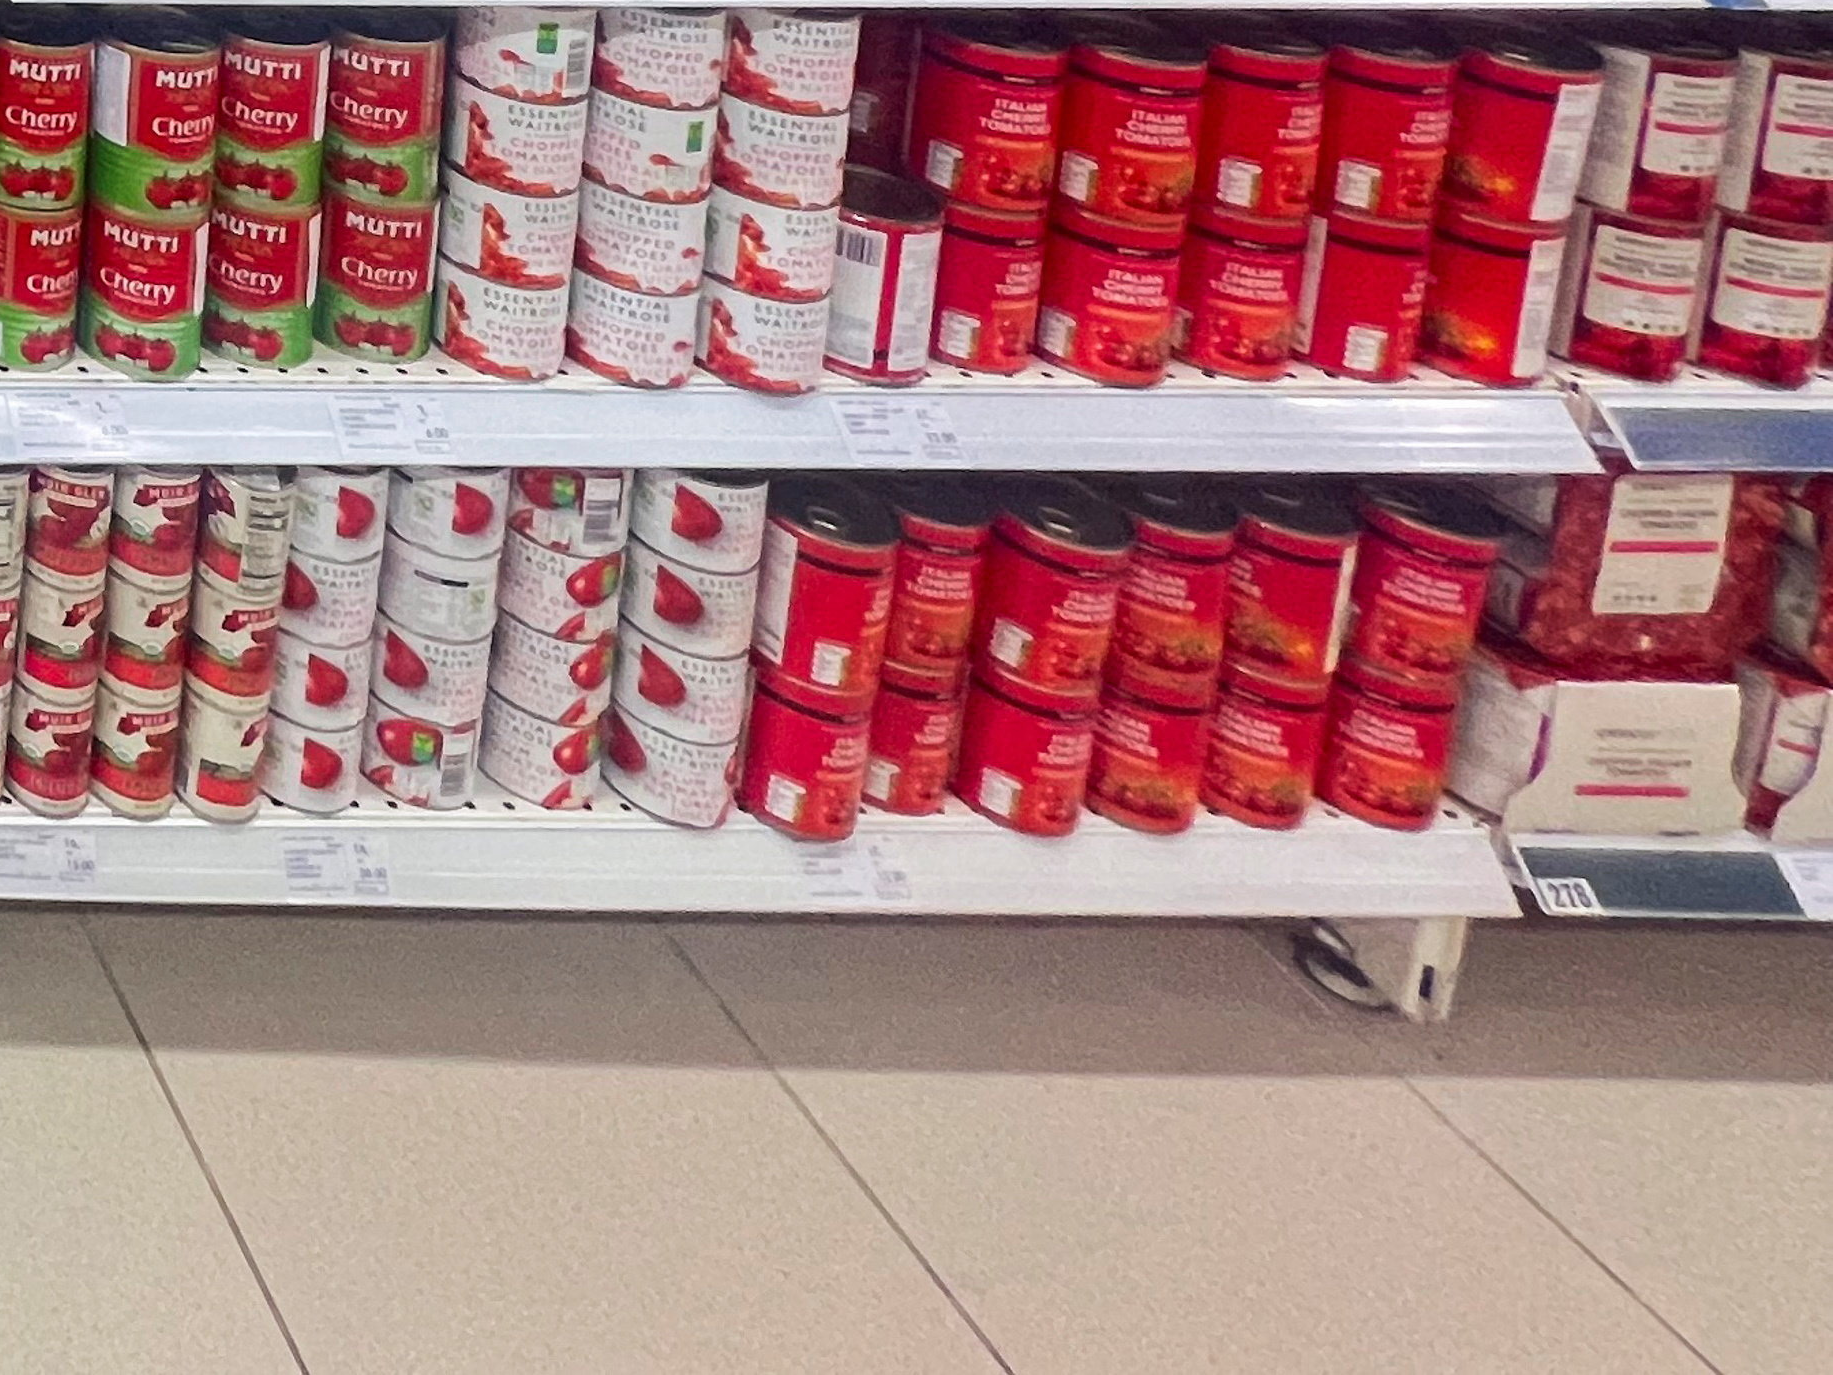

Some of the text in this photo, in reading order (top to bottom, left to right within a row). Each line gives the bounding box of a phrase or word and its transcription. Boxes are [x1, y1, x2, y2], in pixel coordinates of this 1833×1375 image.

[7, 56, 82, 82] MUTTI
[4, 105, 79, 133] Cherry
[1546, 884, 1594, 910] 278
